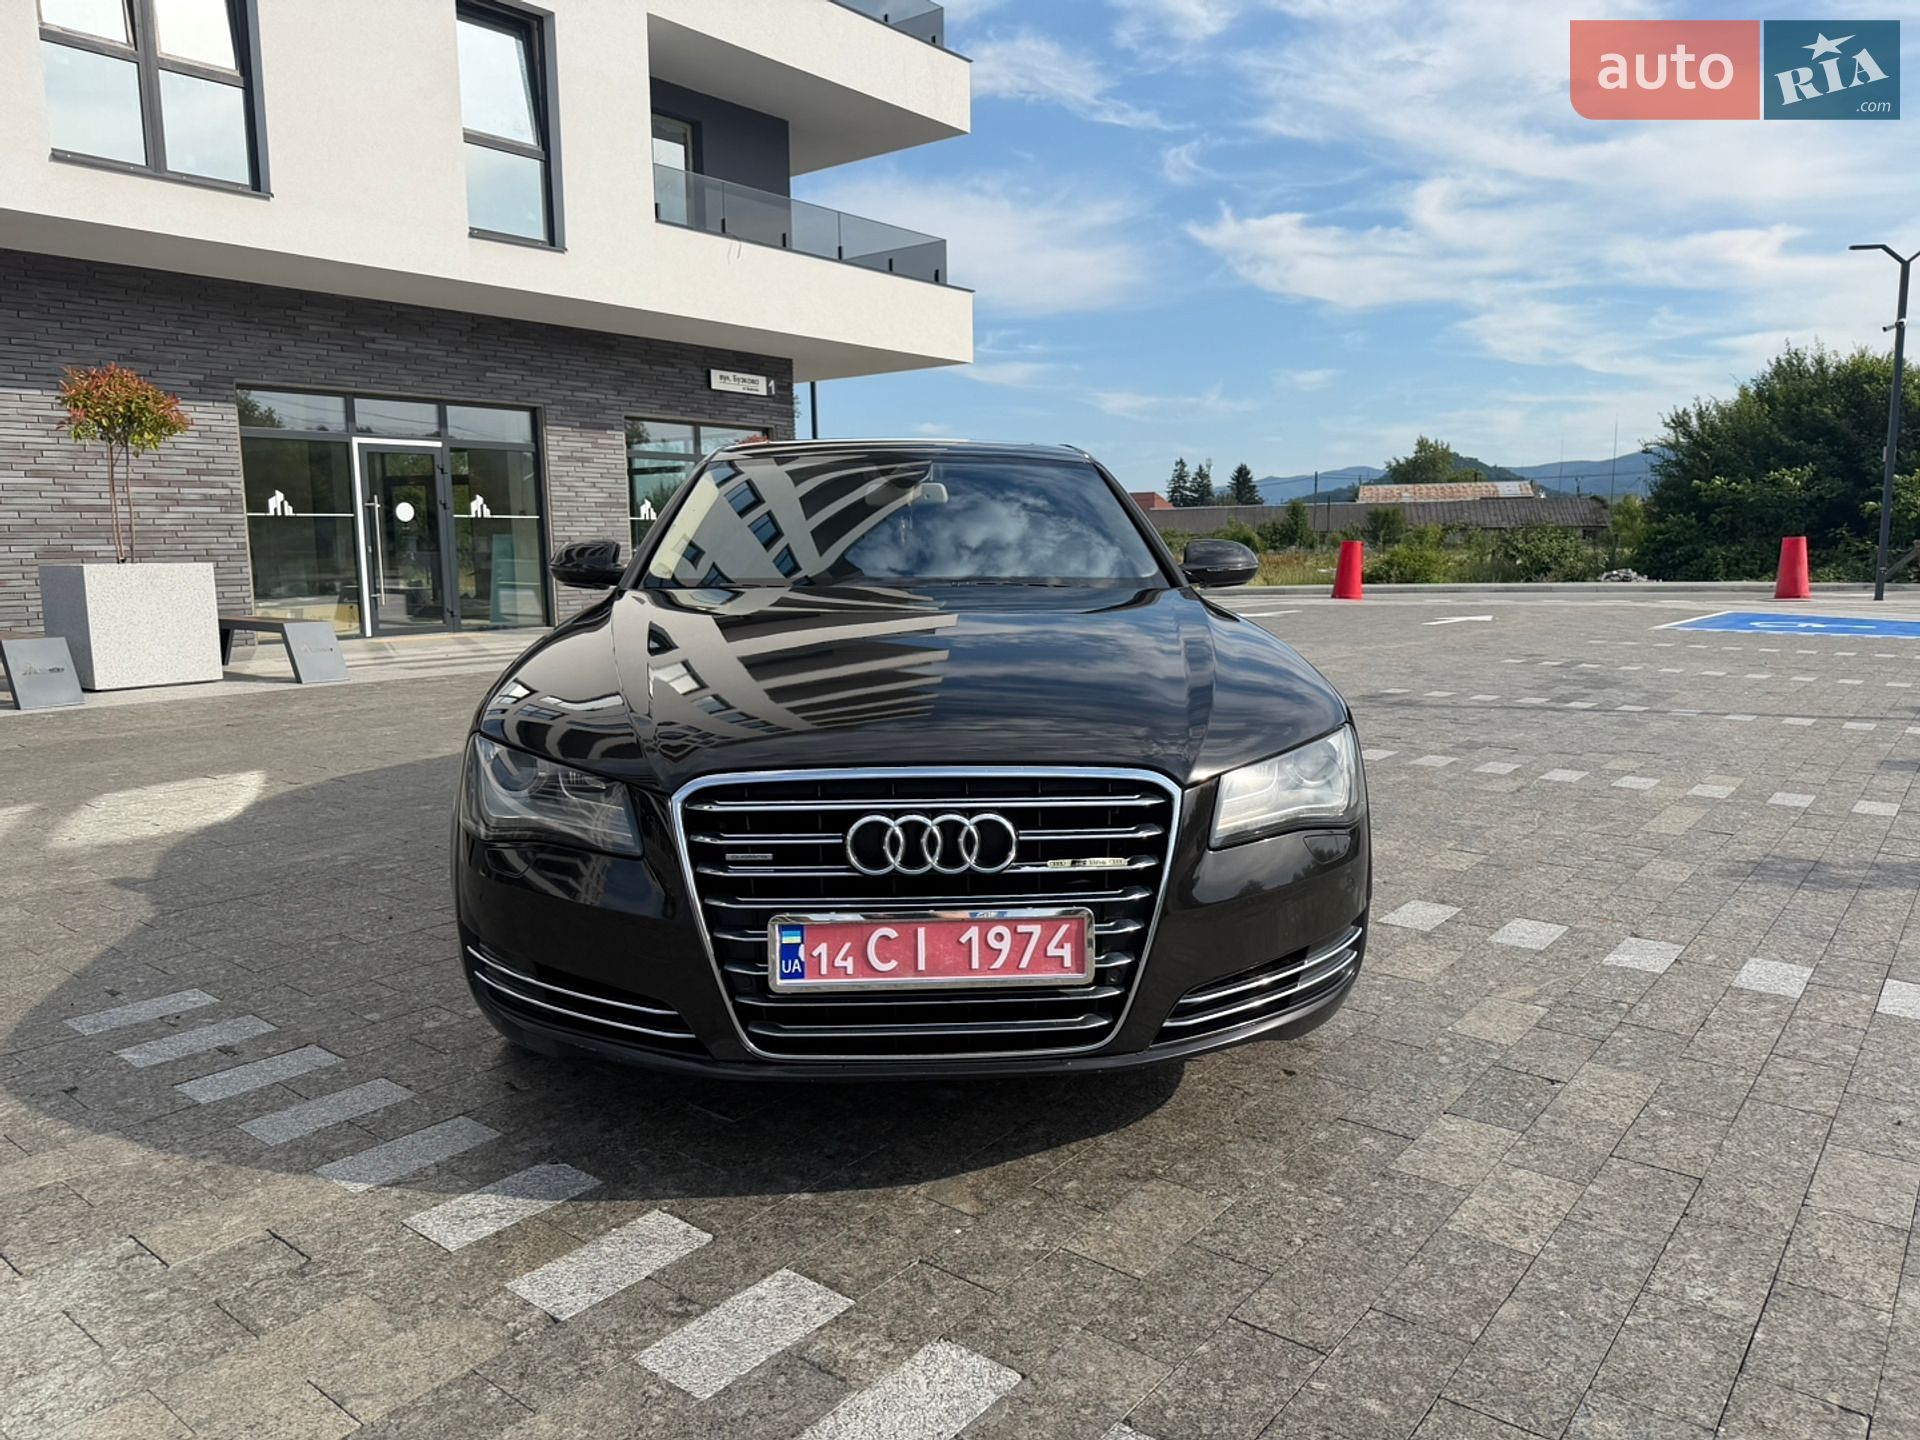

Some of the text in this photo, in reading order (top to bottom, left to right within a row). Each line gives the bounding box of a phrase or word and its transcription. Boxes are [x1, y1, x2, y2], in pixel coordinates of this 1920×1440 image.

[768, 380, 776, 395] 1
[811, 942, 855, 975] 14
[958, 924, 1073, 970] 1974
[782, 959, 802, 974] UA
